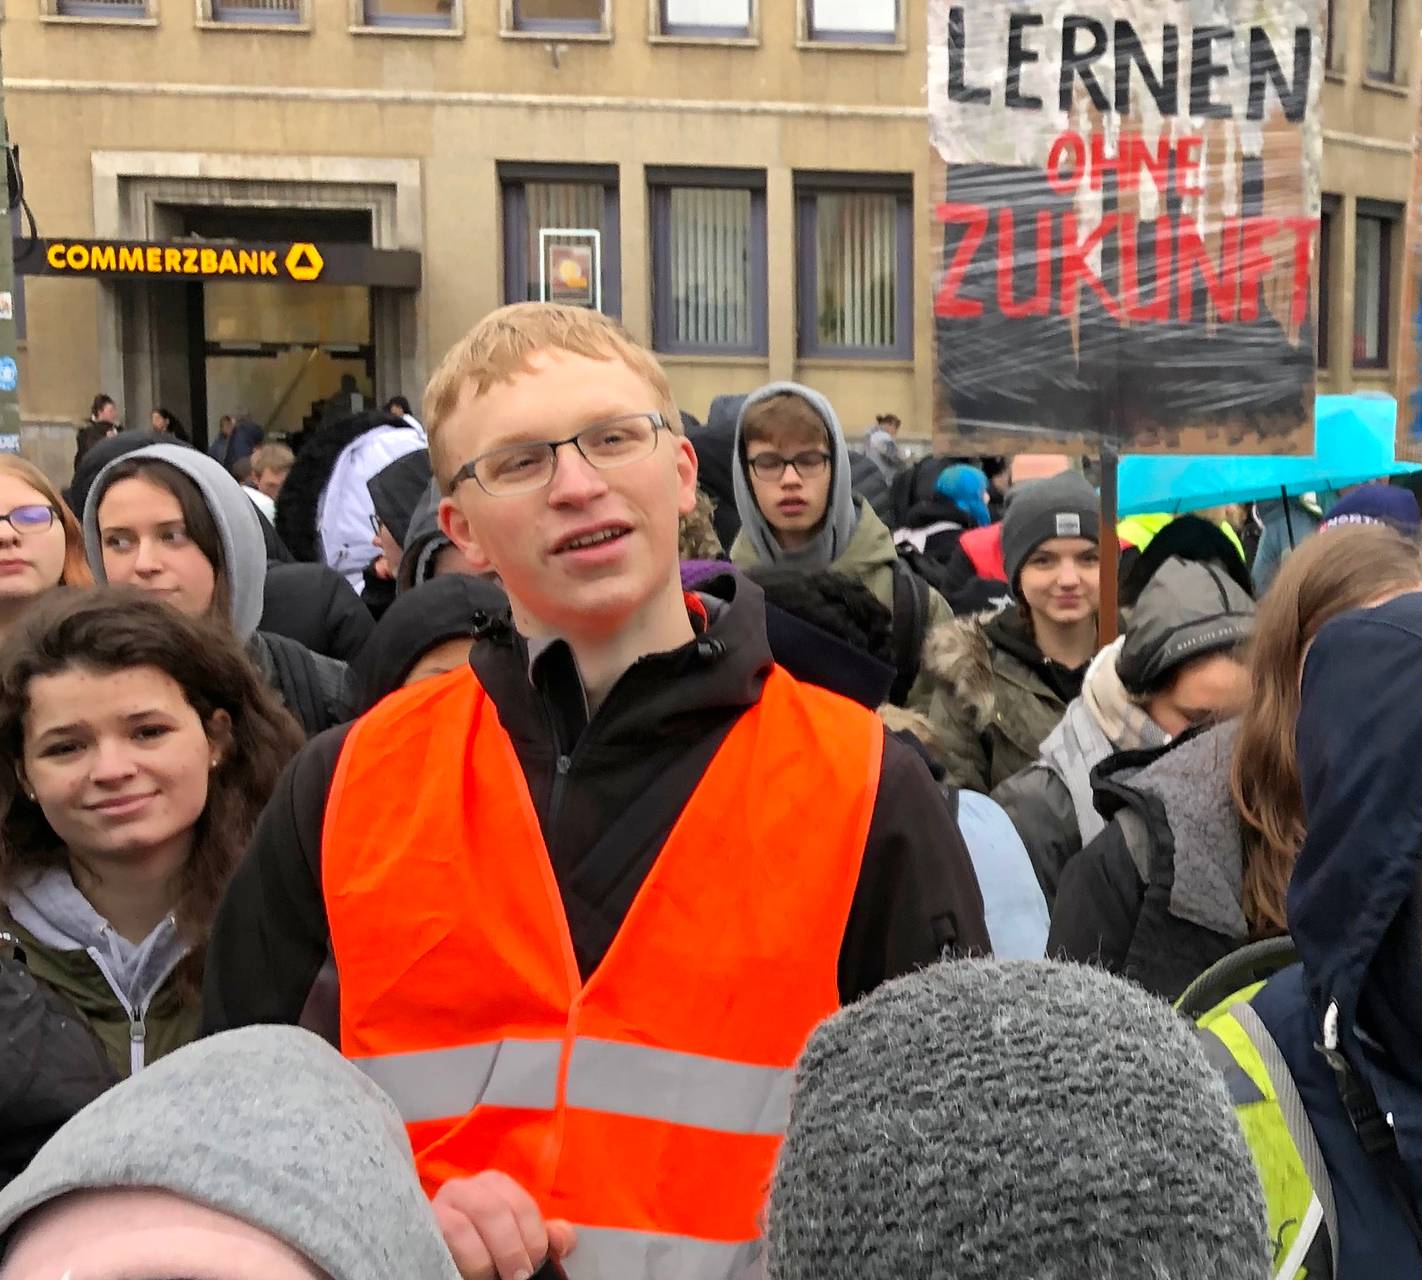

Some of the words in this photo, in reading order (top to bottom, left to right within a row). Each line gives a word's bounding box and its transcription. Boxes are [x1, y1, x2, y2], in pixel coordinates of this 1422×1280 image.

[948, 6, 1312, 123] LERNEN
[1046, 129, 1206, 197] OHNE
[47, 243, 278, 276] COMMERZBANK
[934, 202, 1322, 326] ZUKUNFT
